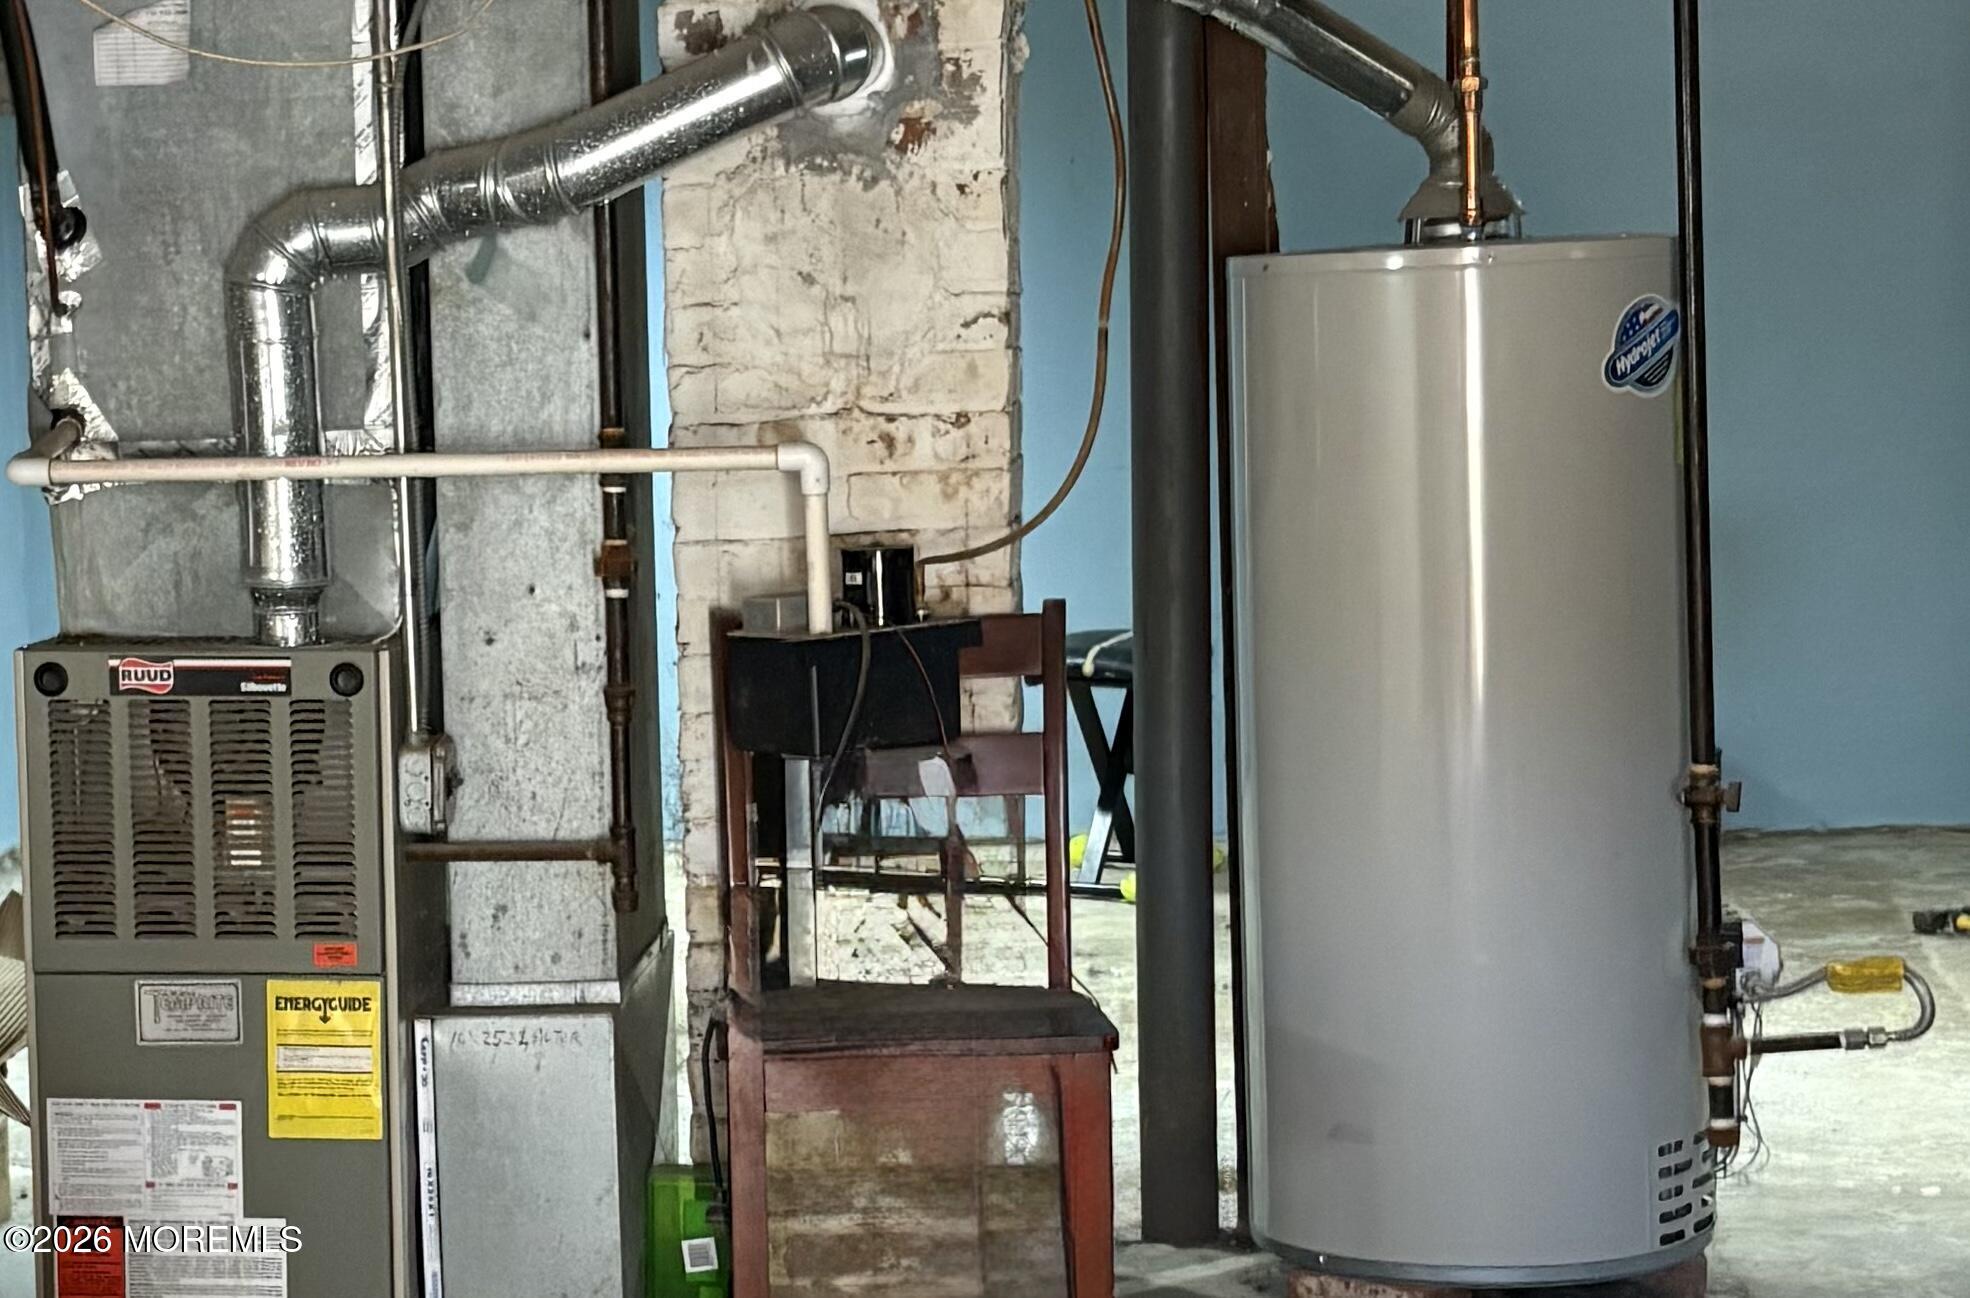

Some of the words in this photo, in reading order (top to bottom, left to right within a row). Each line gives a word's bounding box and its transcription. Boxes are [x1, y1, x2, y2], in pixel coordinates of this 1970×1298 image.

[1615, 328, 1661, 376] Hydrojet
[121, 669, 172, 682] RUUD
[274, 996, 372, 1014] ENERGYGUIDE
